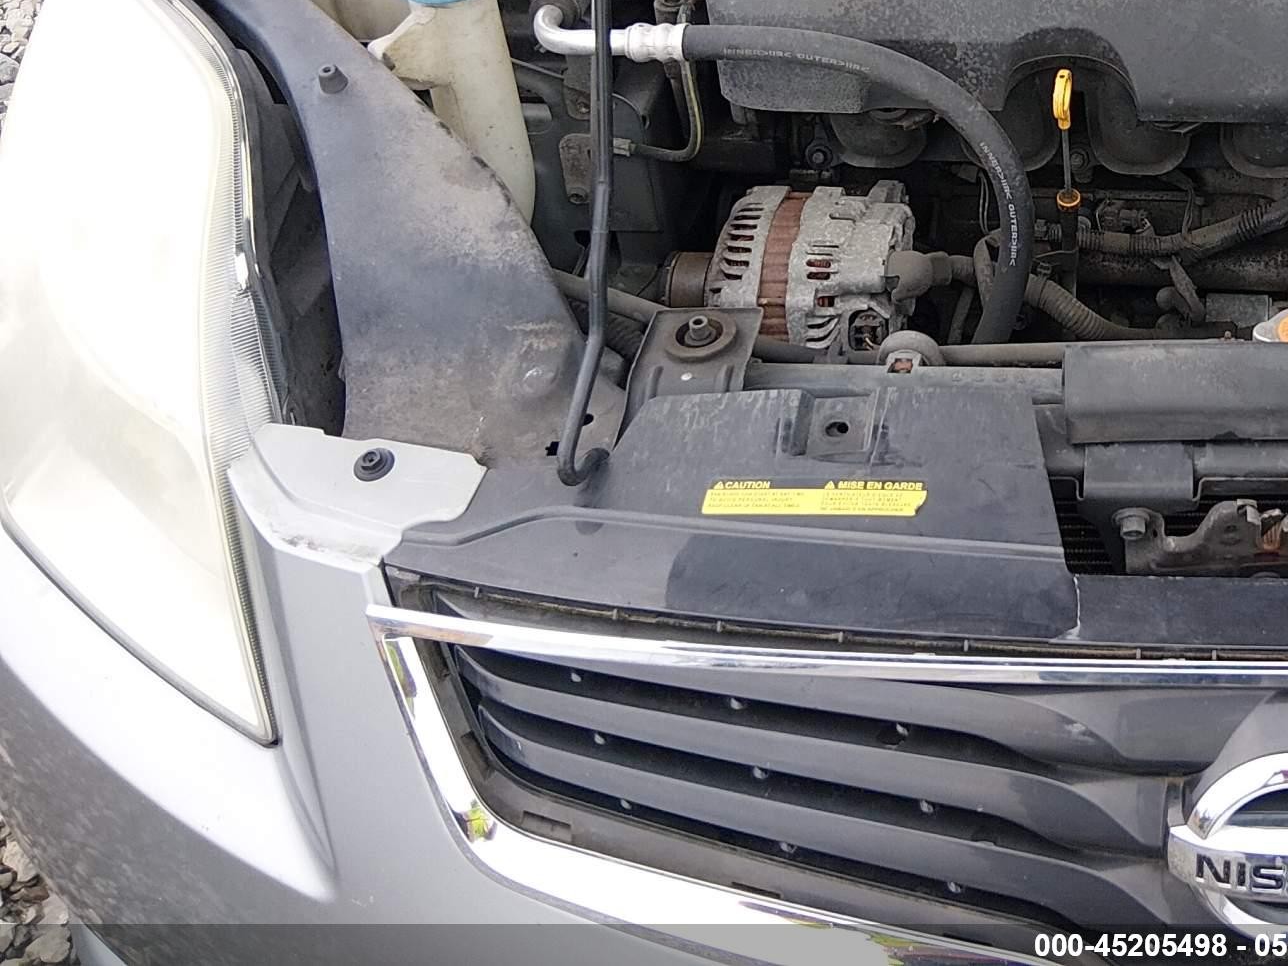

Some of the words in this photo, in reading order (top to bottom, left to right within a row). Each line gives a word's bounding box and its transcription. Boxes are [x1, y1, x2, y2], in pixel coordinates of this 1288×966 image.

[725, 480, 771, 490] CAUTION
[837, 480, 865, 490] MISE
[866, 481, 883, 490] EN
[885, 481, 923, 491] GARDE
